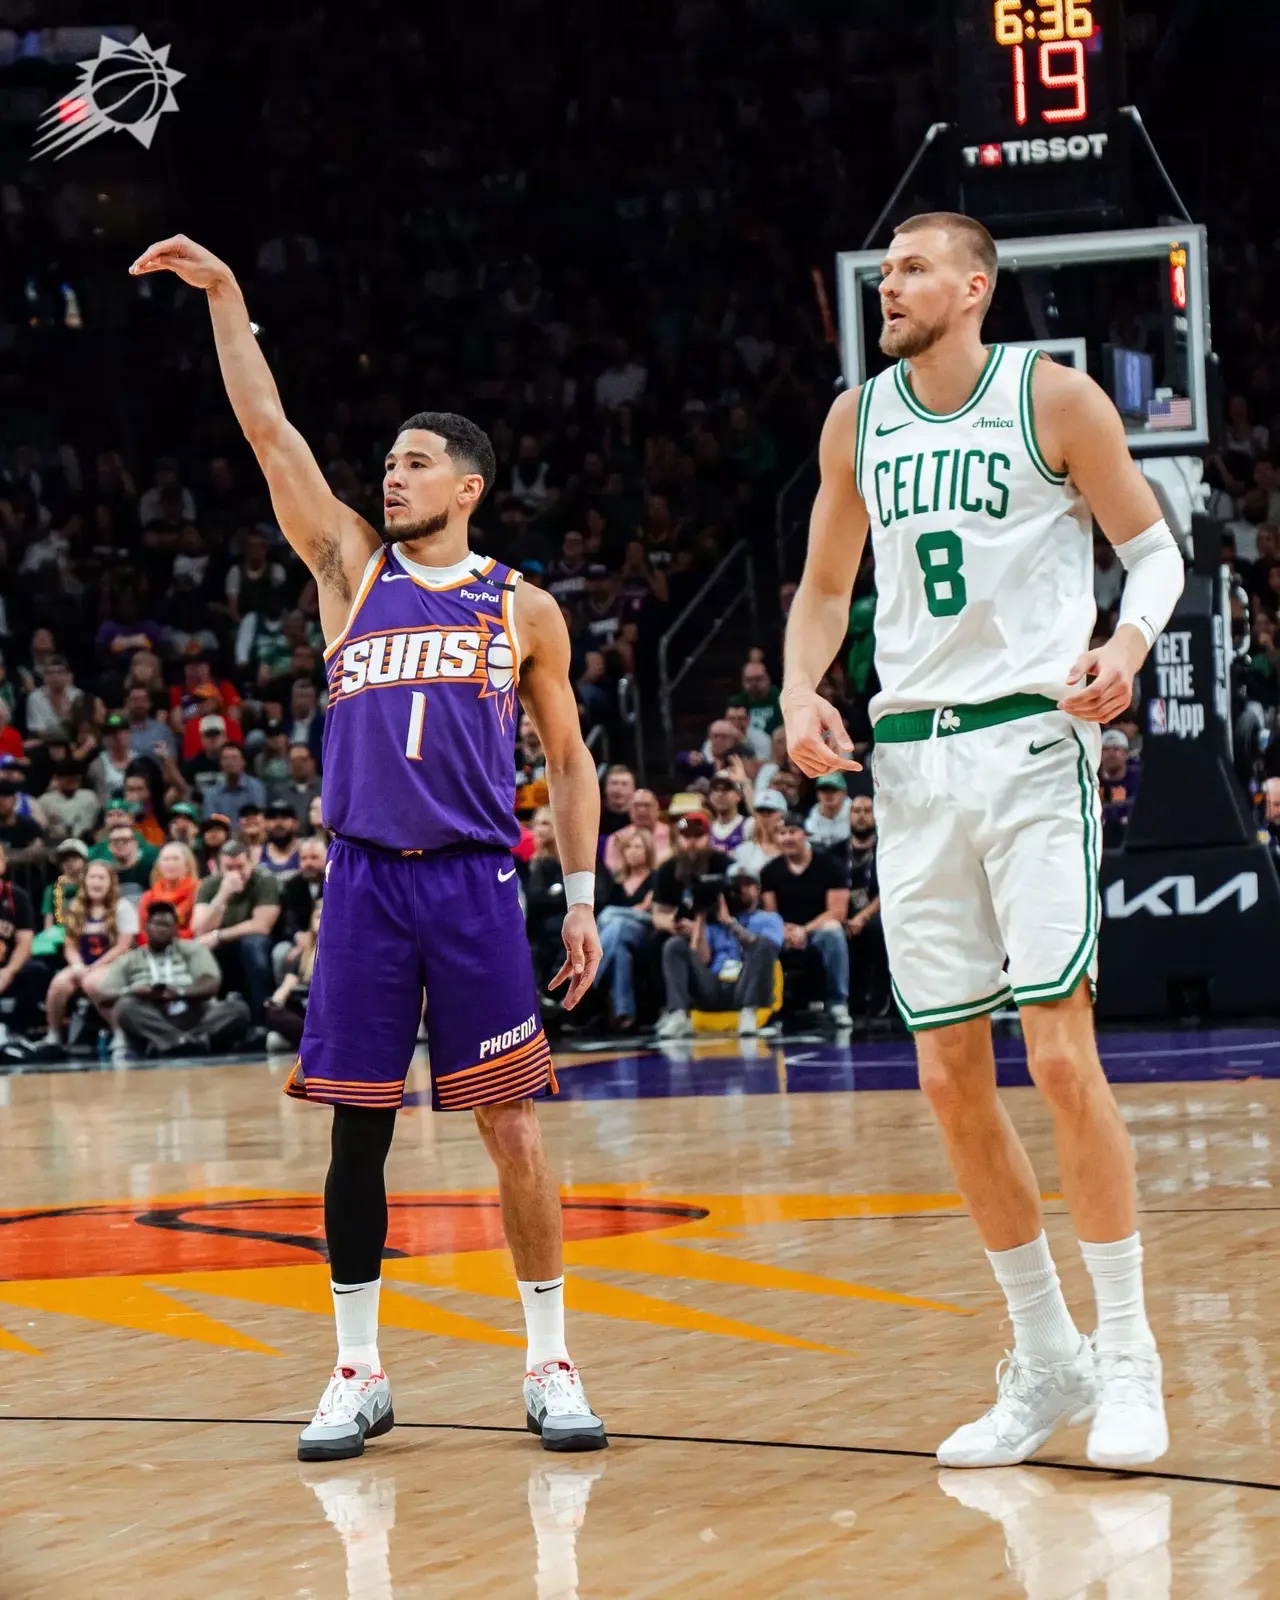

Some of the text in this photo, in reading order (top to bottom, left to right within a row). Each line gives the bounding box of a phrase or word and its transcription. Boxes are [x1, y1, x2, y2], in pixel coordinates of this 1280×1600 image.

[994, 0, 1092, 45] 6:36
[1012, 39, 1087, 126] 19
[1002, 133, 1108, 166] TISSOT
[972, 417, 1014, 428] Amica
[874, 449, 1011, 528] CELTICS
[460, 589, 499, 603] PayPal
[915, 530, 967, 617] 8
[341, 631, 480, 694] SUNS
[1155, 631, 1192, 664] GET
[1157, 664, 1195, 698] THE
[405, 691, 426, 761] 1
[1167, 698, 1204, 739] App
[1105, 872, 1259, 918] KIA
[479, 1013, 537, 1059] PHOENIX
